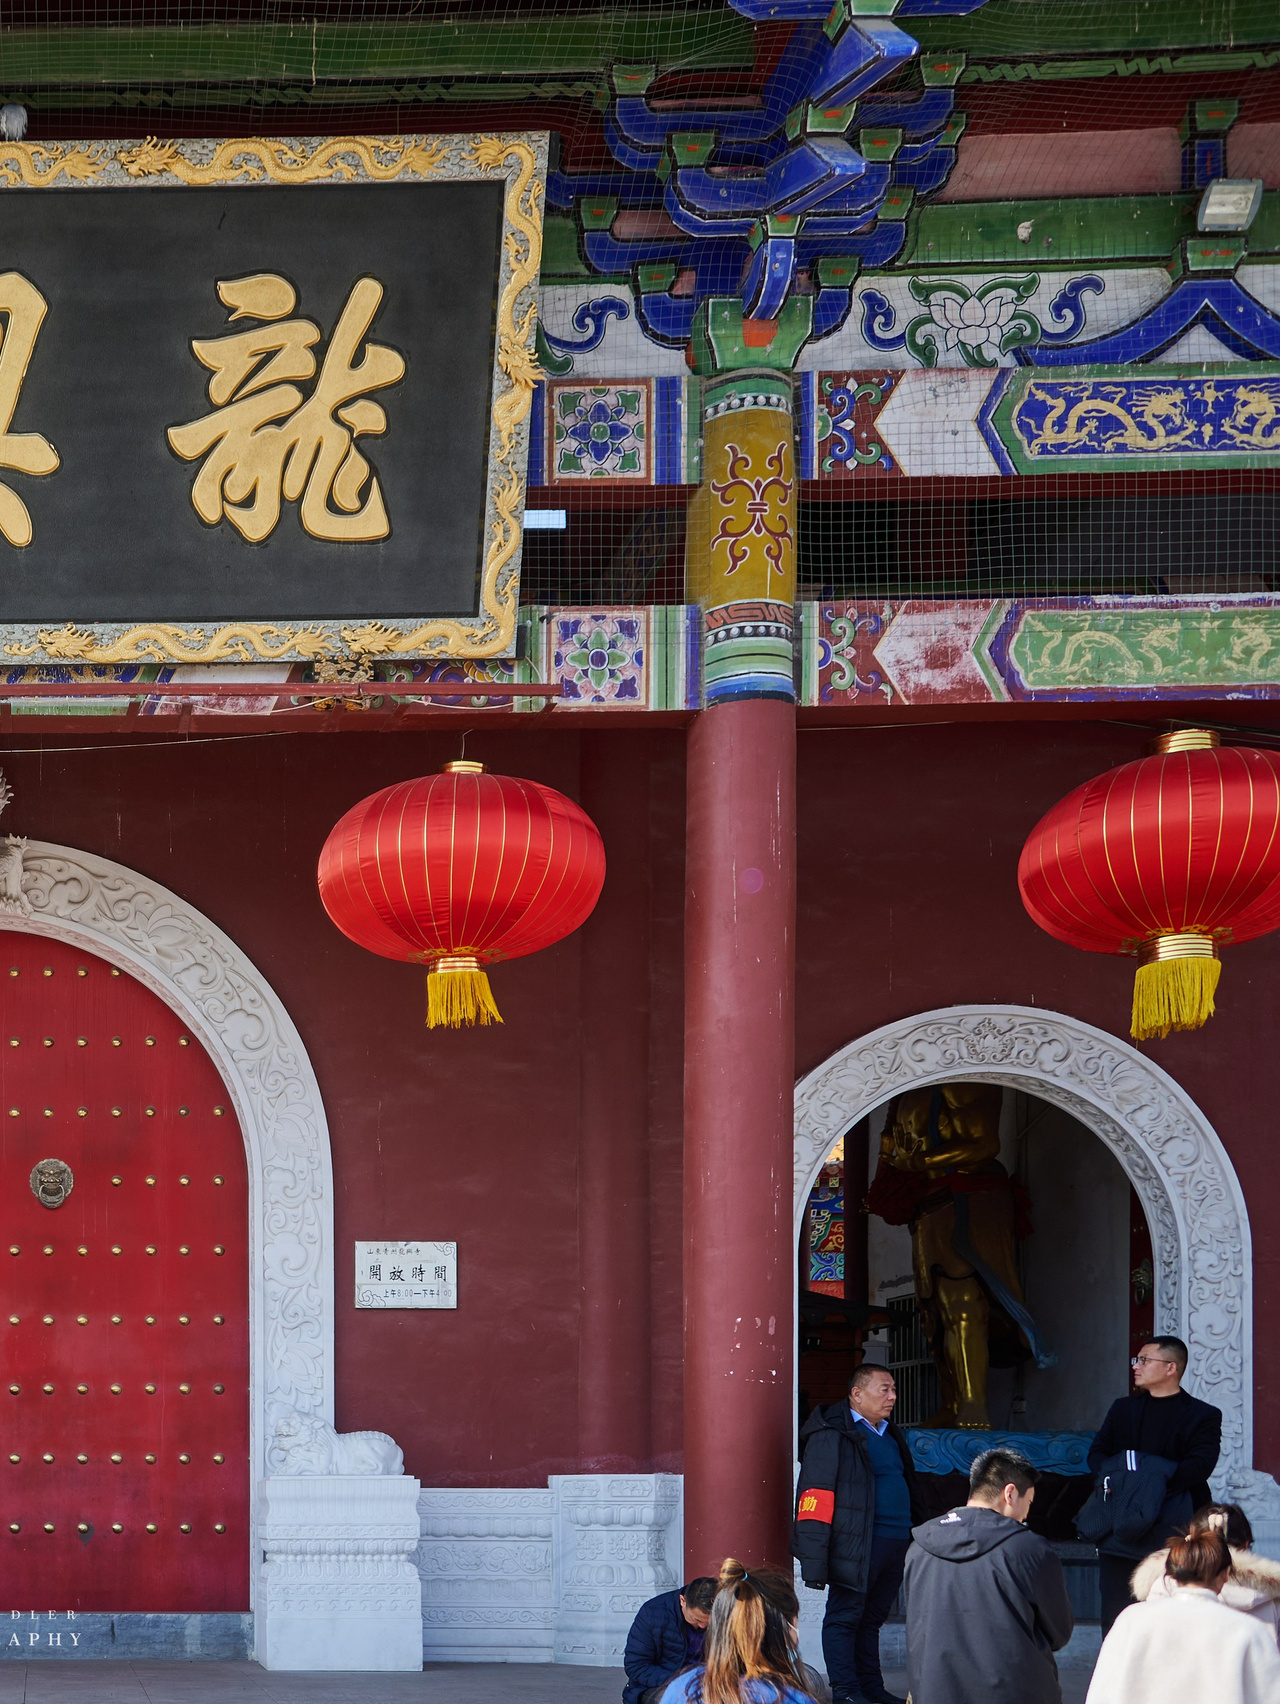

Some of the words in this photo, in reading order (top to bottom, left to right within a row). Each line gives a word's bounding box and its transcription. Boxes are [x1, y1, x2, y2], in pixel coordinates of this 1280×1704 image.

[369, 1264, 447, 1282] 開放時間
[799, 1496, 818, 1512] 勤
